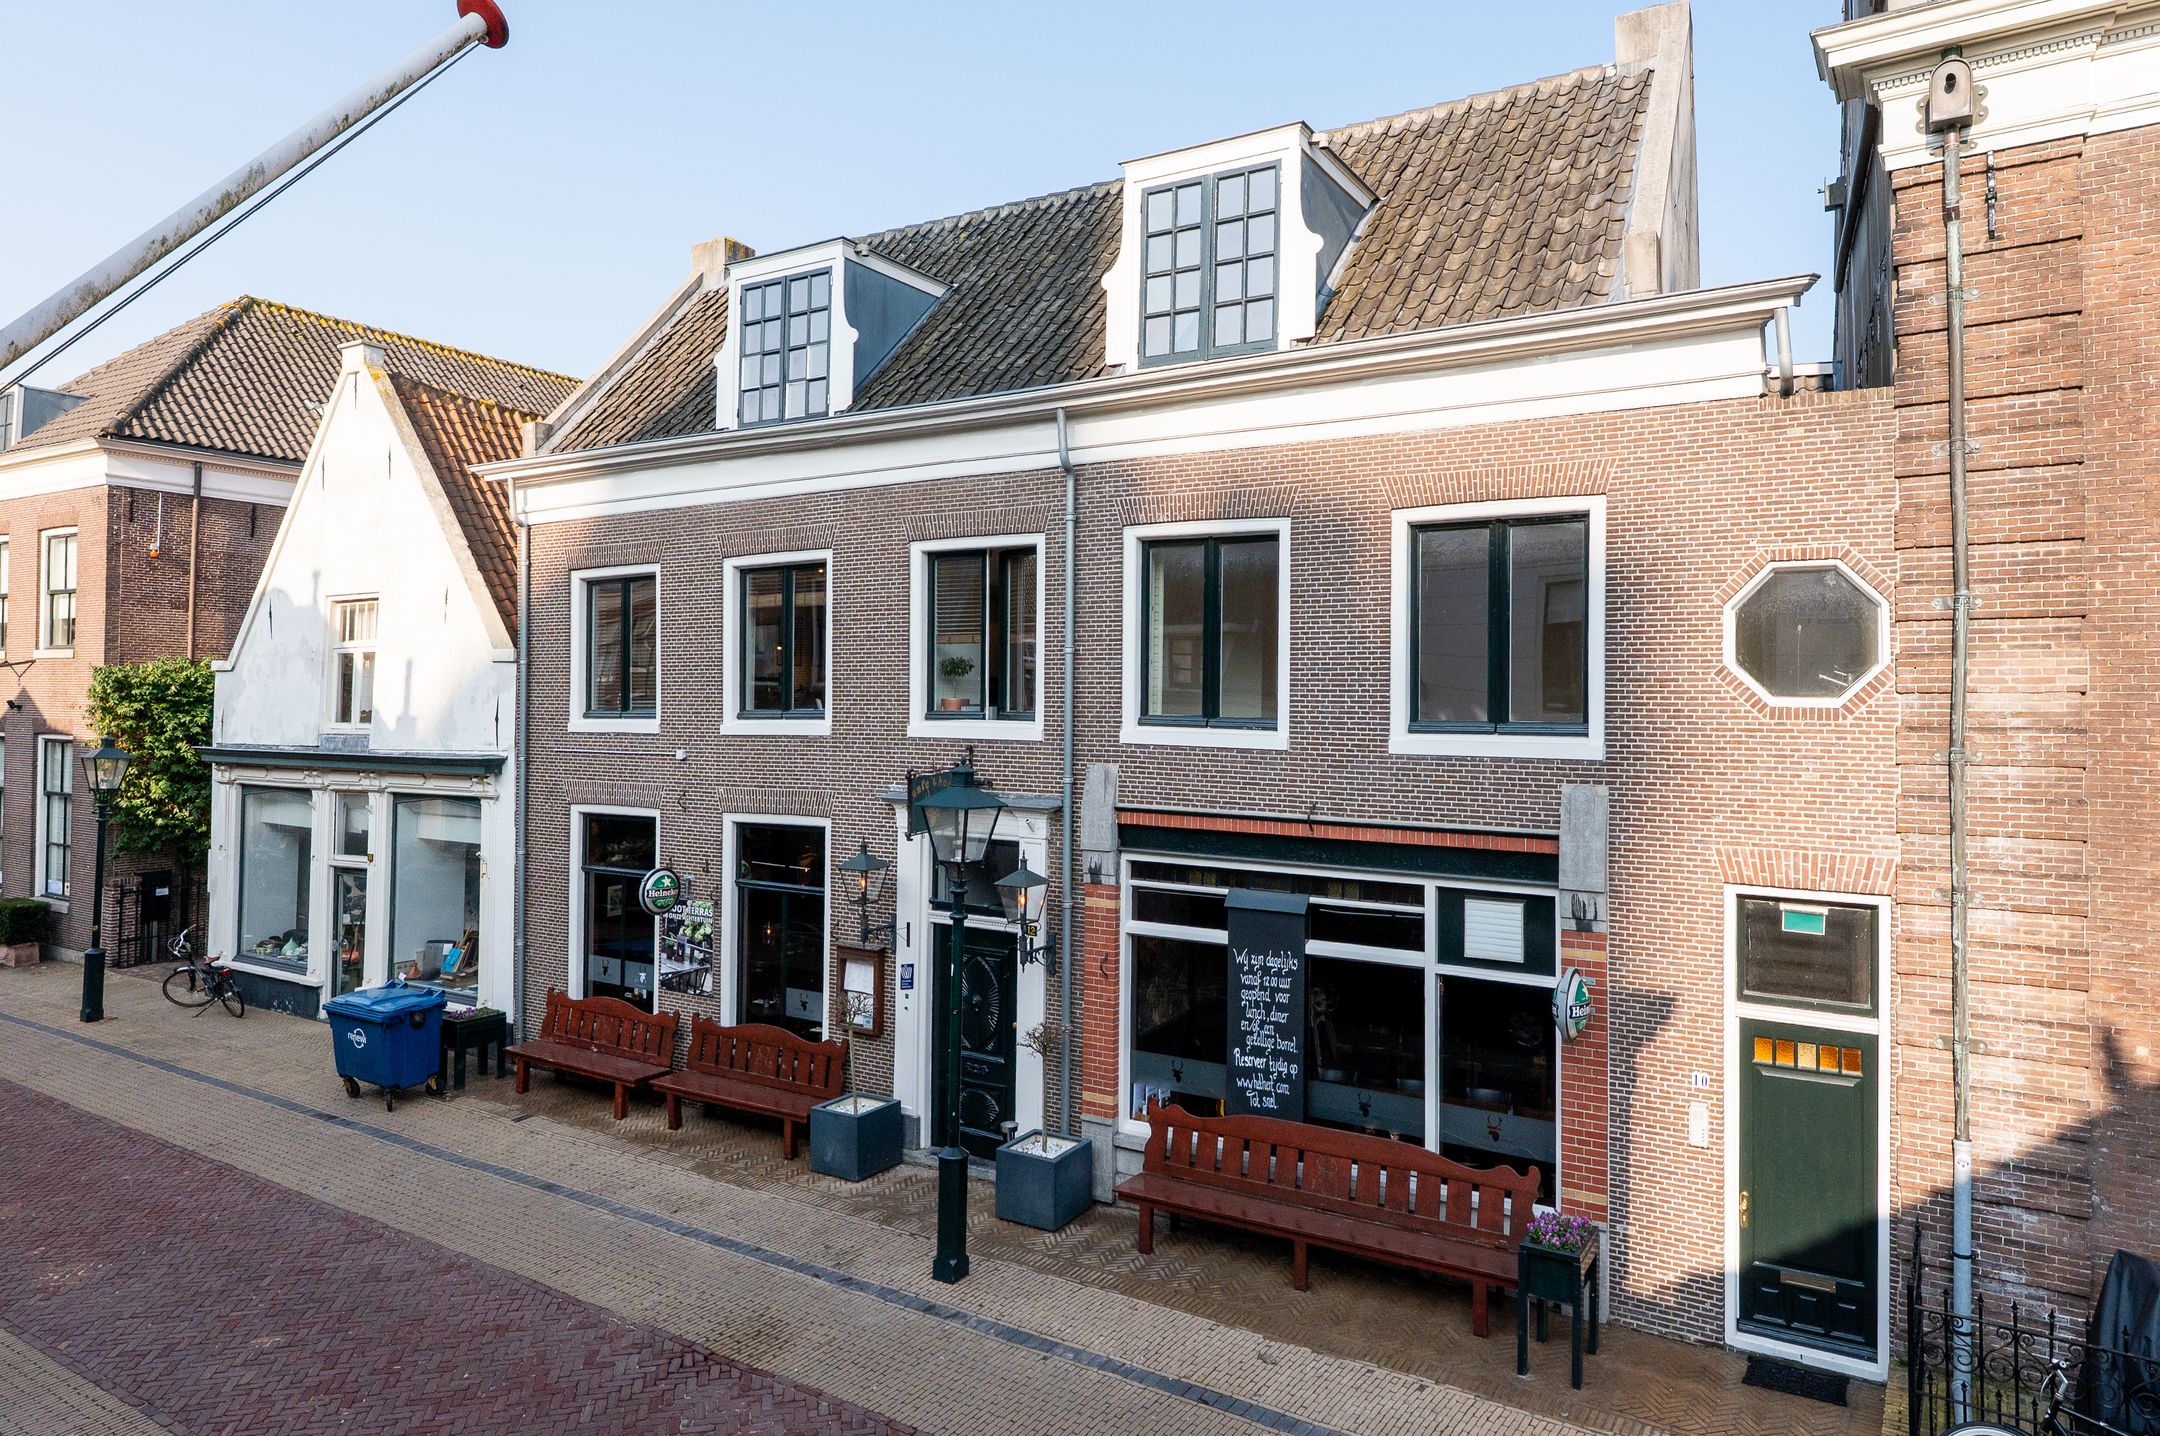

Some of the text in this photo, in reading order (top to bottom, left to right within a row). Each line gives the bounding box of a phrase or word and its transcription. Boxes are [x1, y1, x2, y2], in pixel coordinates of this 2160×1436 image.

[687, 906, 714, 917] TERRAS
[1028, 926, 1036, 935] 12
[1265, 949, 1299, 975] dagelijks
[1240, 970, 1262, 992] vanaf
[1278, 977, 1292, 989] uur
[1240, 987, 1291, 1007] geopend voor
[1270, 1005, 1290, 1024] diner
[1263, 1024, 1275, 1036] een
[1246, 1030, 1275, 1056] gezellige
[1233, 1047, 1298, 1080] Reserveer tijdig op
[1694, 1074, 1708, 1087] 10
[1246, 1089, 1261, 1108] Tot
